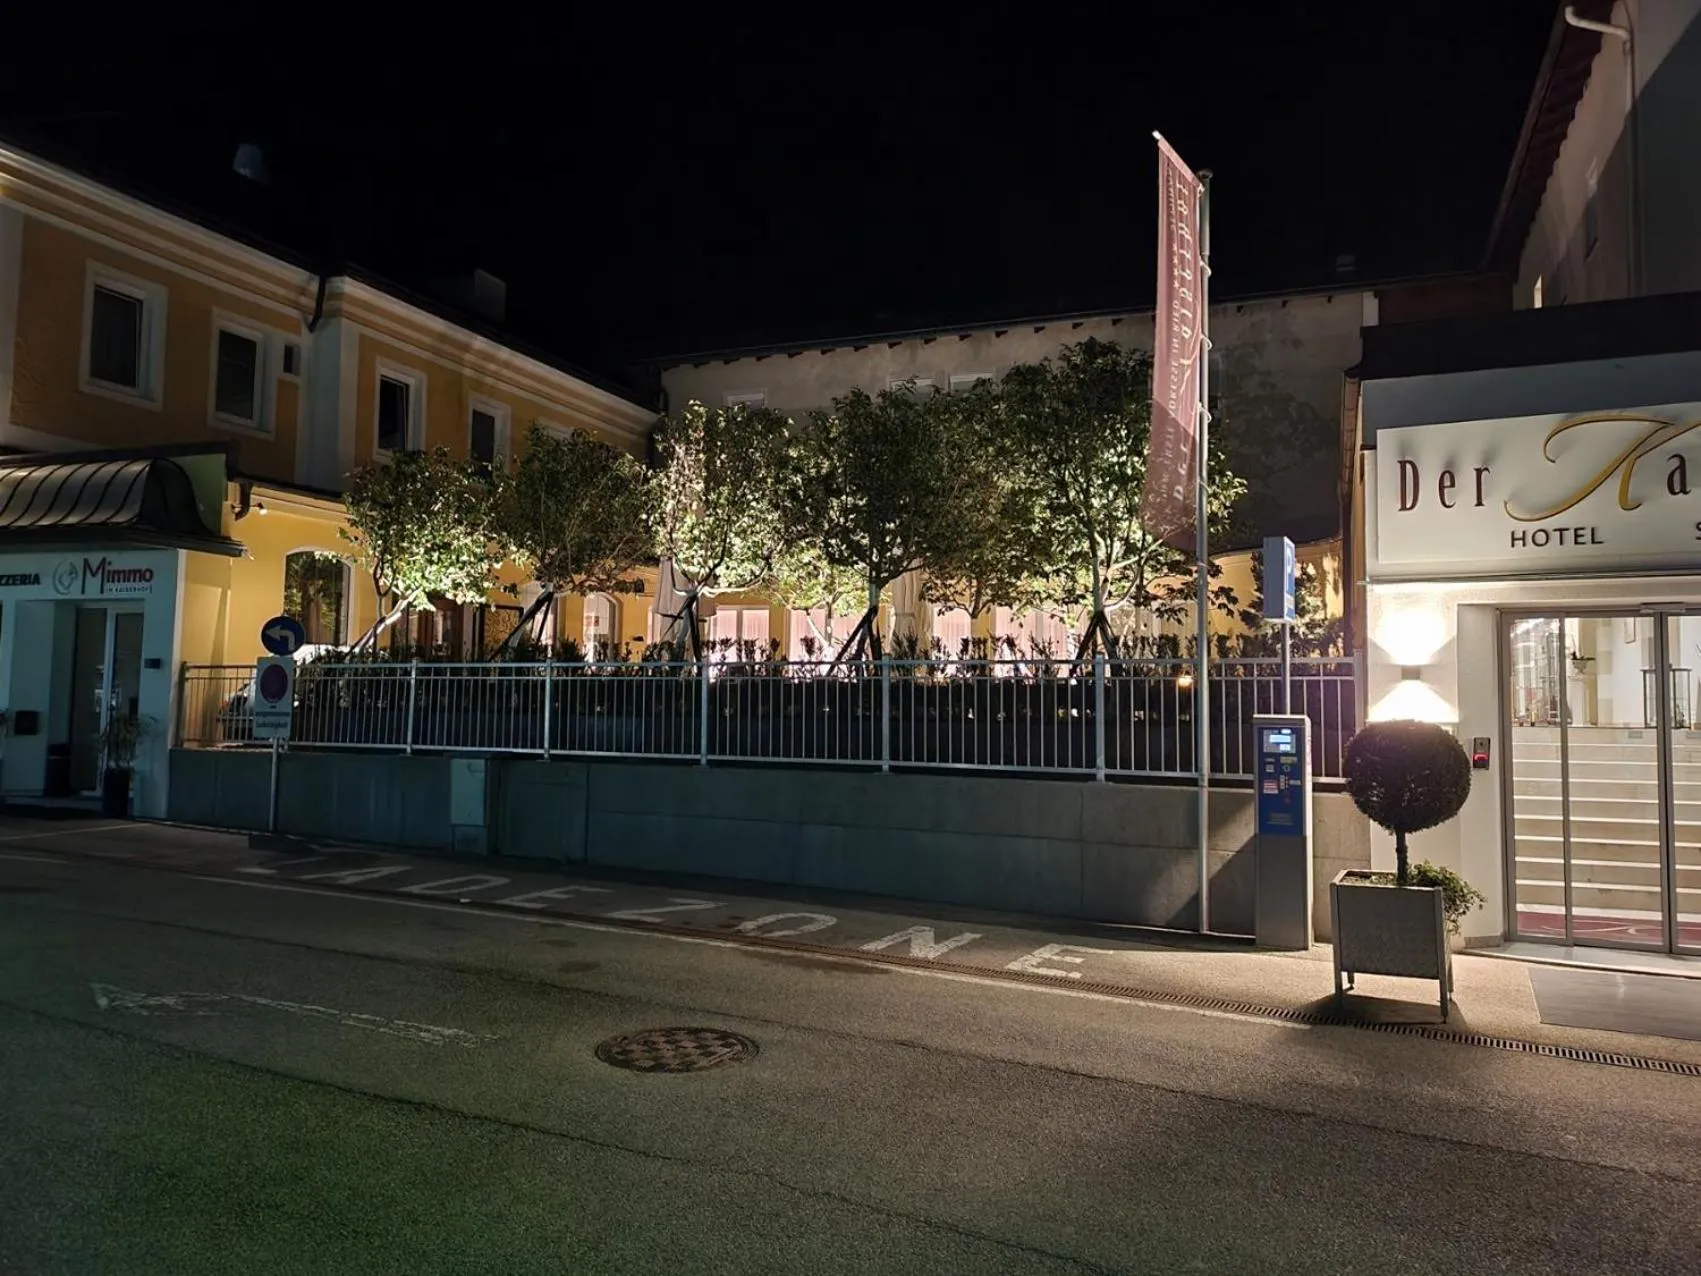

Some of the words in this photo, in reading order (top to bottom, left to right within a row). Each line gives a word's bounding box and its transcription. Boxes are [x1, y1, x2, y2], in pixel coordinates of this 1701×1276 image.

[1397, 459, 1491, 511] Der
[1510, 527, 1605, 548] HOTEL
[81, 556, 154, 595] Mimmo
